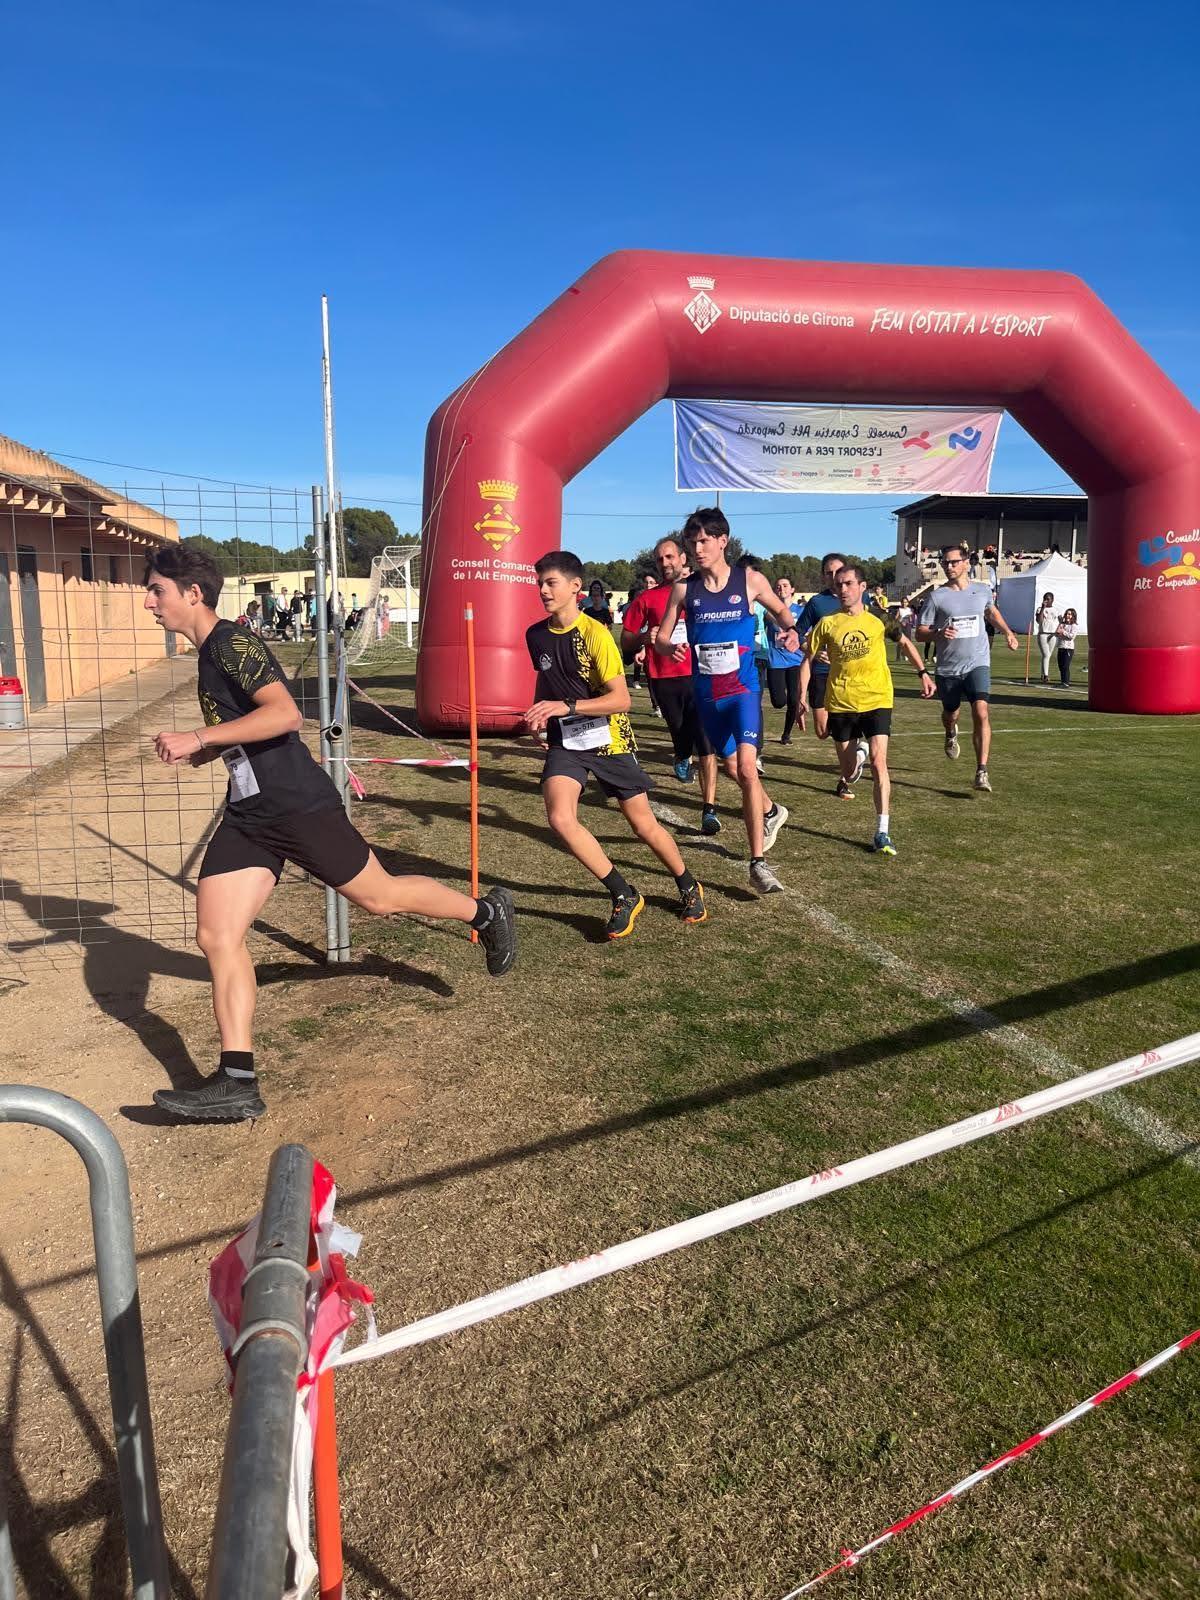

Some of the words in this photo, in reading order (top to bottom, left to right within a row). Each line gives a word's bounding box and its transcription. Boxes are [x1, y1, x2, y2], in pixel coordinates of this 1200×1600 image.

[729, 306, 791, 324] Diputació
[793, 312, 810, 325] de
[812, 312, 855, 327] Girona
[870, 308, 905, 333] FEM
[909, 311, 966, 334] COSTAT
[963, 314, 975, 335] A
[979, 314, 1052, 336] L'ESPORT
[1166, 528, 1200, 544] Consell
[451, 558, 490, 568] Consell
[492, 559, 537, 573] Comarca
[453, 571, 466, 580] de
[492, 571, 537, 585] Empordà
[1133, 577, 1152, 591] Alt
[844, 643, 866, 651] TRAIL
